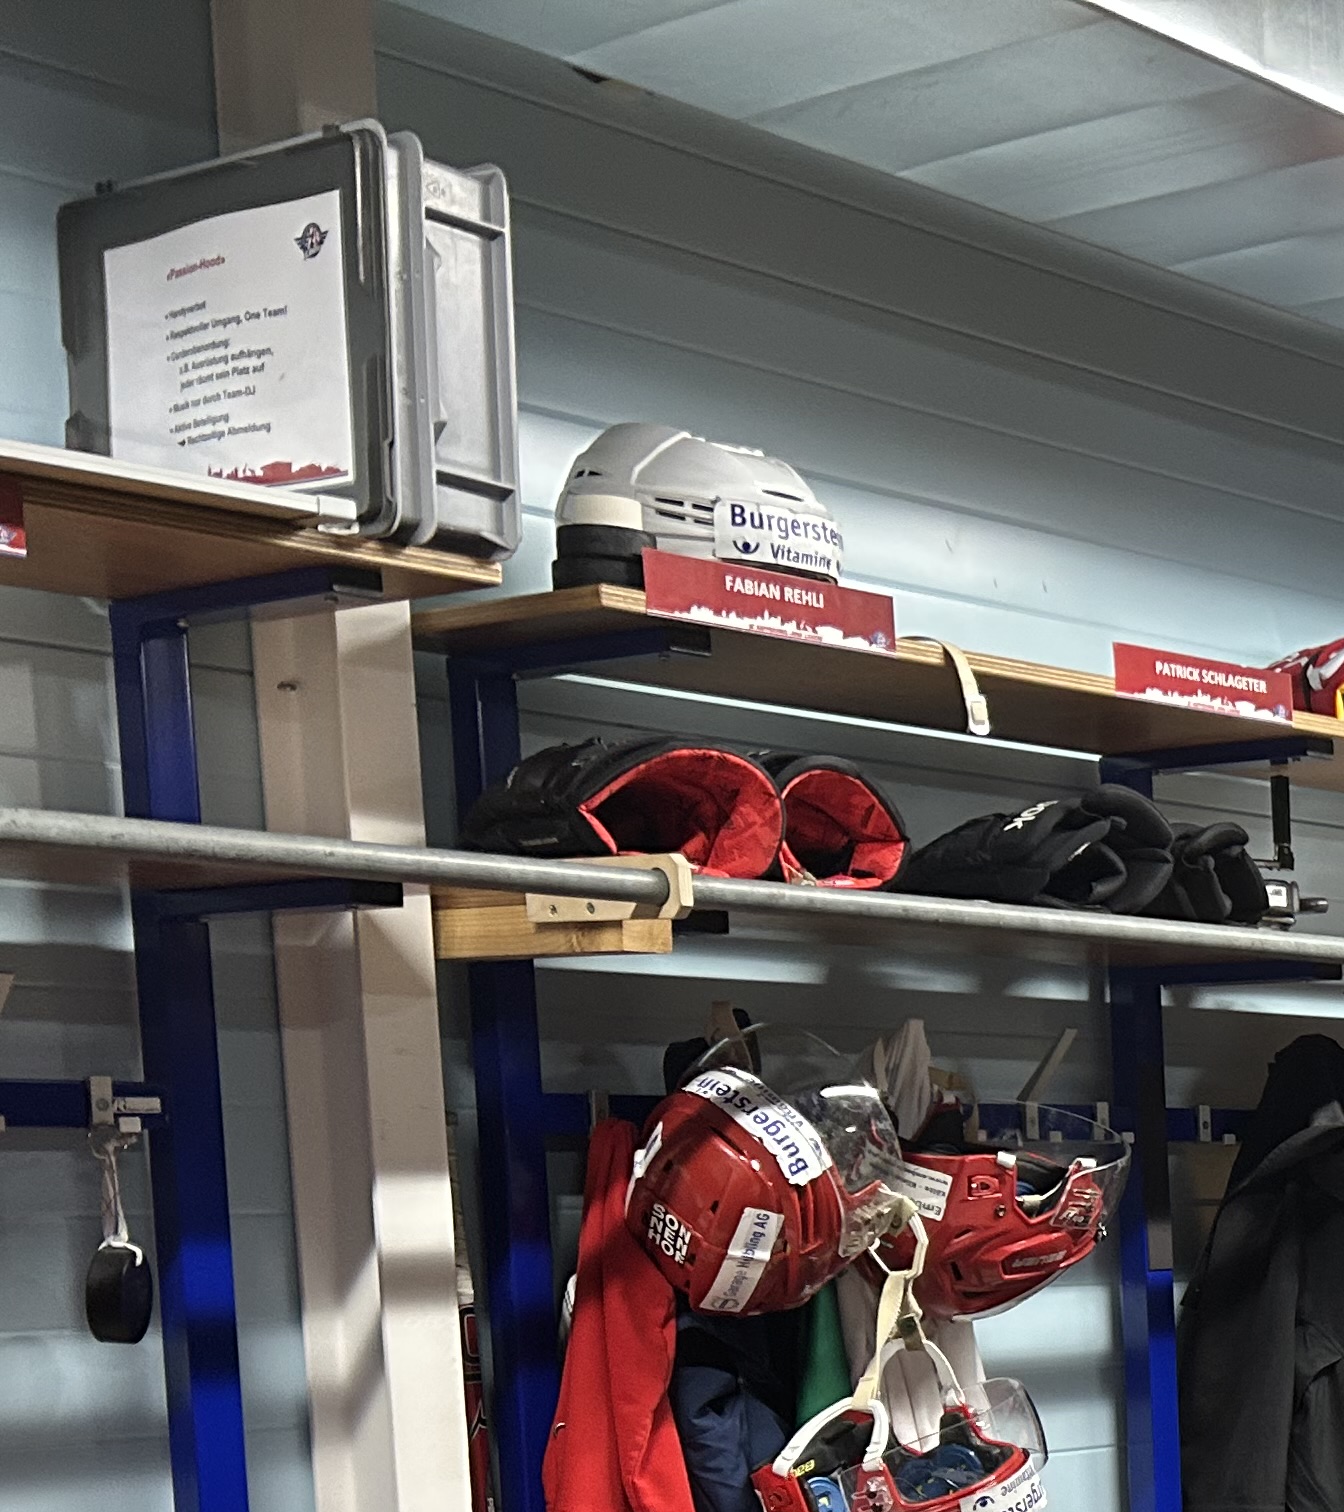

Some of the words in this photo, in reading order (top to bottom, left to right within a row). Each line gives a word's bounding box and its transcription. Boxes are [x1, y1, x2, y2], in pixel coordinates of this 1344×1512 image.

[244, 310, 261, 321] One
[725, 575, 781, 601] FABIAN
[784, 586, 825, 609] REHLI
[1155, 661, 1200, 682] PATRICK
[1201, 669, 1268, 694] SCHLAGETER
[698, 1076, 809, 1178] Burgerstein
[756, 1211, 771, 1227] AG
